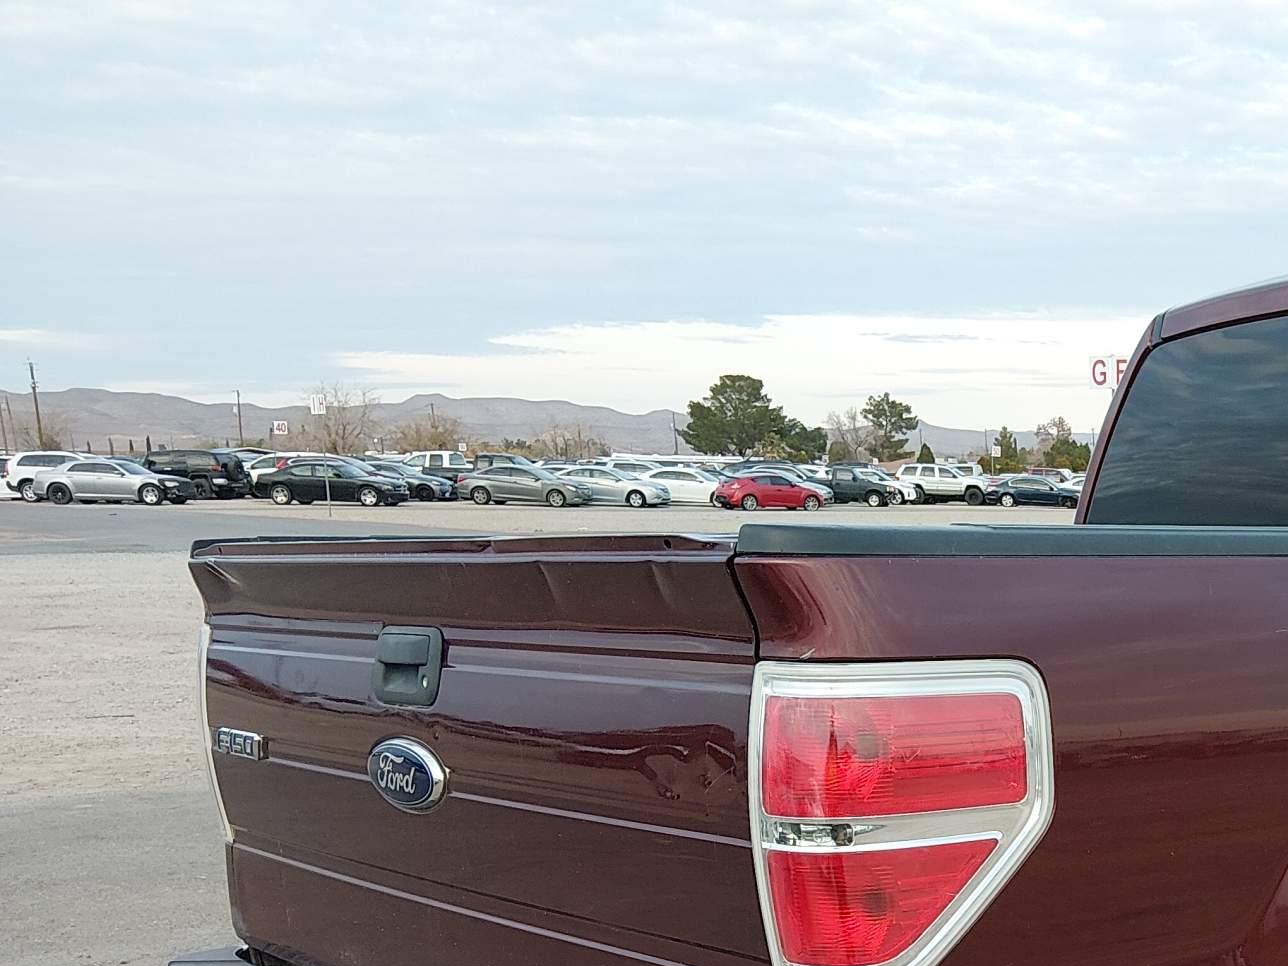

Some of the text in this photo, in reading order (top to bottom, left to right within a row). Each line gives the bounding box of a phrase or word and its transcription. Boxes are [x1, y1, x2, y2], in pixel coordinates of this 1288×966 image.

[1092, 359, 1107, 385] G
[275, 422, 287, 432] 40
[377, 752, 416, 794] Ford
